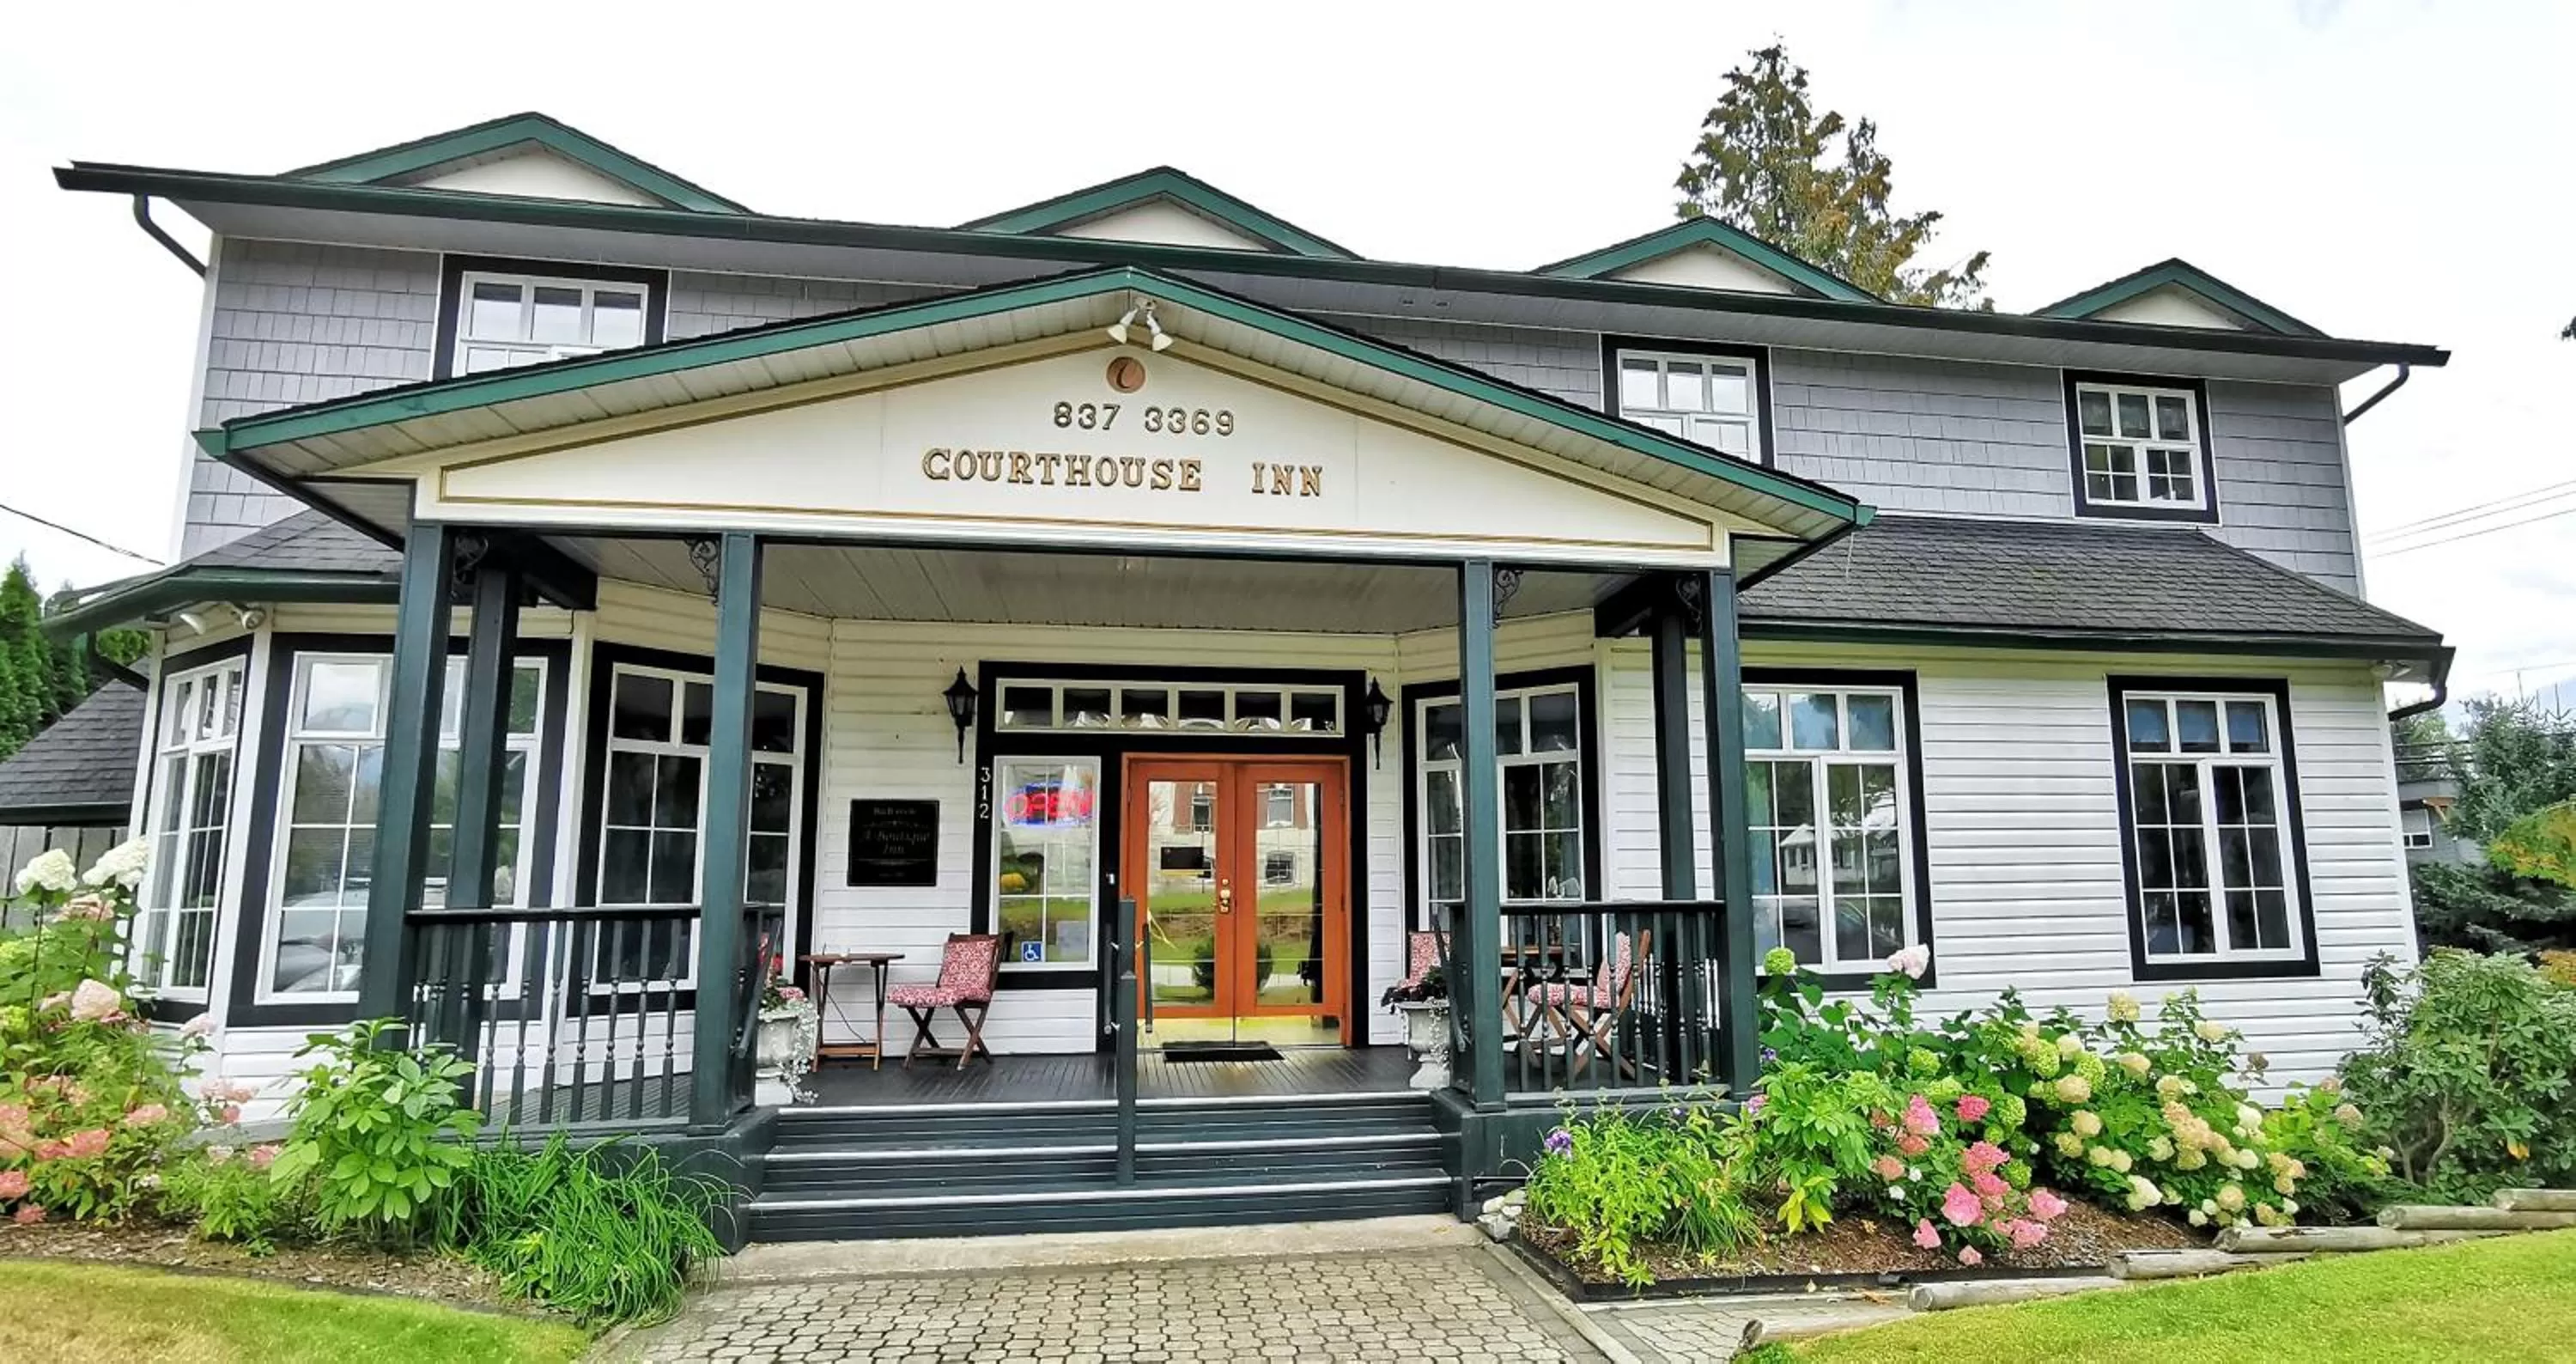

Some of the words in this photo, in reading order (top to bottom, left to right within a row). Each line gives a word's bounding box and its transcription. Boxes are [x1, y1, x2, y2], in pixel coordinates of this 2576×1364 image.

[1054, 401, 1121, 430] 837
[1145, 406, 1234, 436] 3369
[921, 448, 1202, 492] COURTHOUSE
[1252, 461, 1322, 496] INN
[980, 766, 991, 819] 312
[1005, 789, 1094, 819] OPEN
